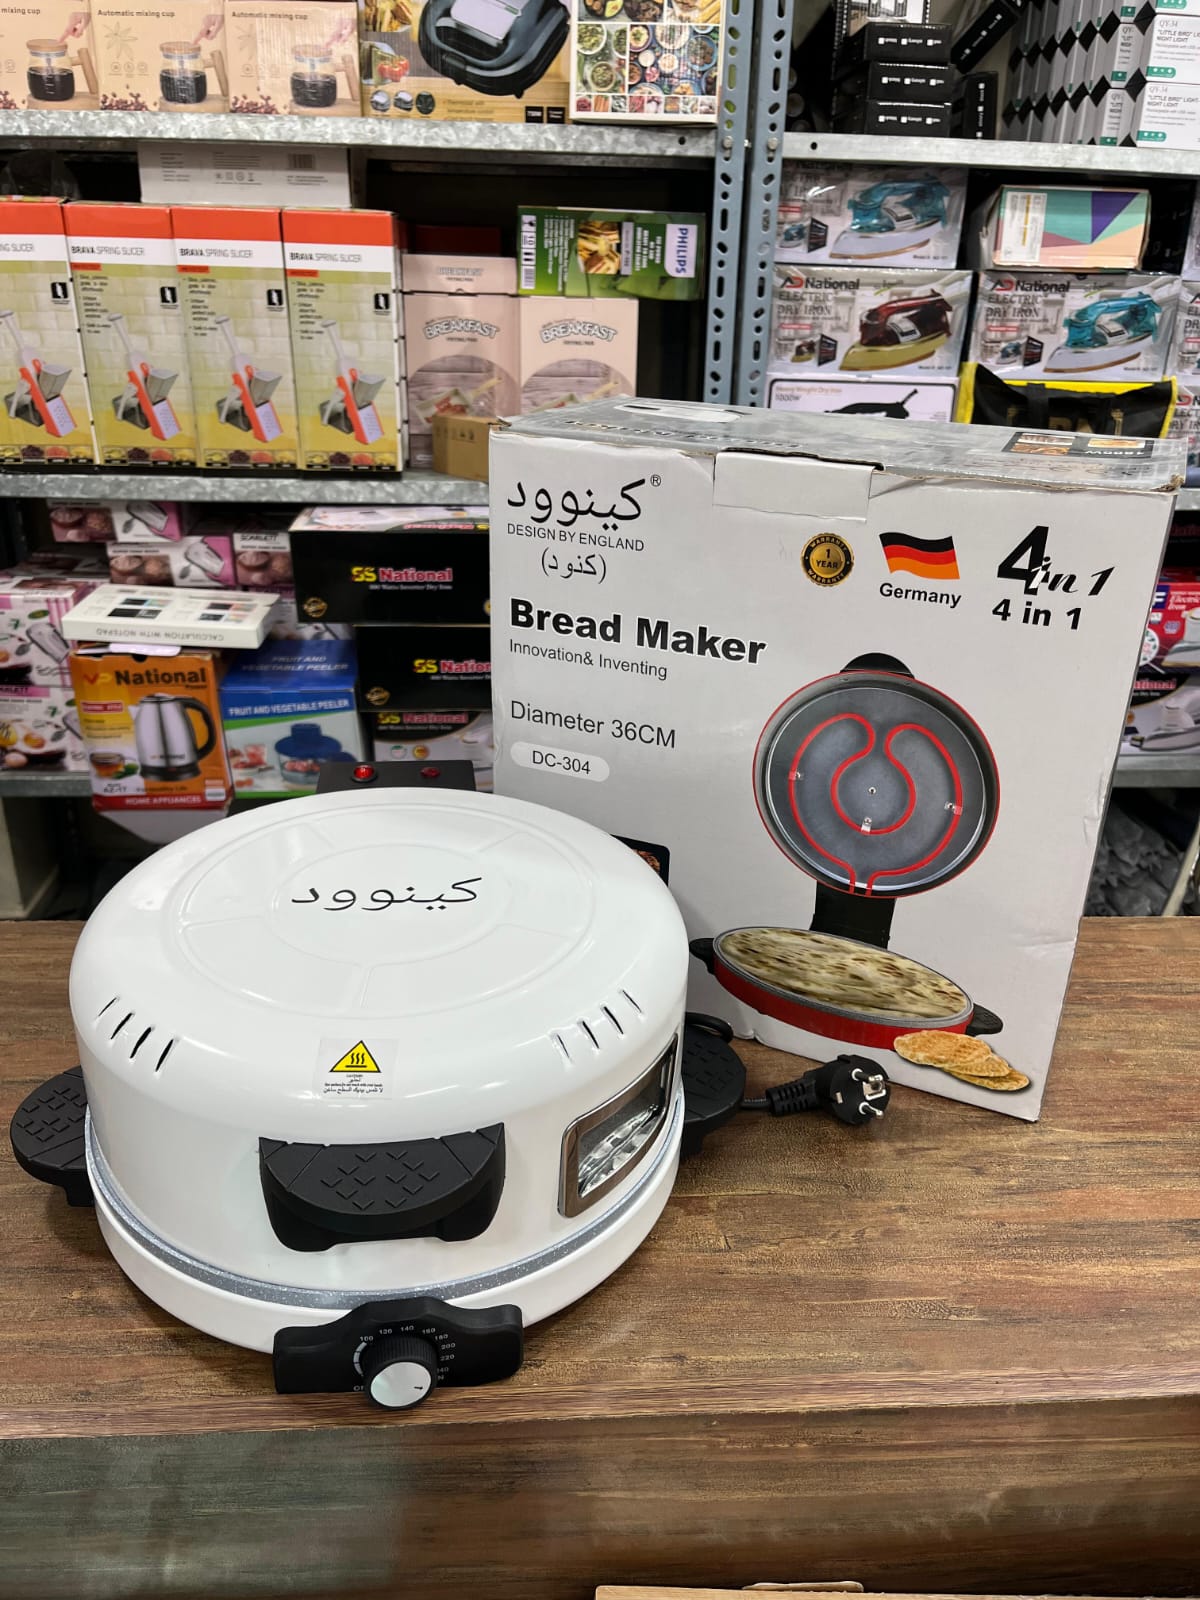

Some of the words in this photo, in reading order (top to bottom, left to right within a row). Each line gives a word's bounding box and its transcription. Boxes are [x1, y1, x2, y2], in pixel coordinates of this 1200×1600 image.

[71, 246, 95, 254] BRAVA
[180, 249, 204, 257] BRAVA
[675, 226, 690, 275] PHILIPS
[805, 277, 860, 290] National
[1015, 280, 1070, 292] National
[987, 293, 1042, 305] ELECTRIC
[804, 304, 832, 315] IRON
[985, 307, 1007, 318] DRY
[1011, 307, 1041, 318] IRON
[422, 318, 501, 340] BREAKFAST
[539, 319, 619, 344] BREAKFAST
[506, 477, 646, 532] كينوود
[507, 523, 556, 540] DESIGN
[559, 530, 576, 542] BY
[578, 533, 645, 551] ENGLAND
[825, 548, 831, 559] 1
[997, 525, 1049, 596] 4
[1087, 566, 1116, 597] 1
[816, 560, 838, 569] YEAR
[378, 567, 453, 582] National
[879, 582, 962, 609] Germany
[991, 598, 1012, 622] 4
[1022, 601, 1051, 627] in
[1066, 607, 1082, 631] 1
[139, 630, 162, 639] WITH
[165, 631, 225, 642] CALCULATION
[509, 598, 623, 645] Bread
[636, 616, 767, 665] Maker
[440, 659, 491, 674] Nation
[509, 638, 594, 666] Innovation&
[599, 654, 668, 682] Inventing
[114, 668, 207, 686] National
[229, 705, 253, 717] FRUIT
[254, 704, 271, 715] AND
[271, 701, 317, 714] VEGETABLE
[318, 698, 350, 711] PEELER
[402, 713, 469, 724] National
[510, 700, 605, 736] Diameter
[611, 719, 676, 749] 36CM
[532, 750, 591, 775] DC-304
[291, 877, 482, 911] كينوود
[441, 1342, 456, 1350] 200
